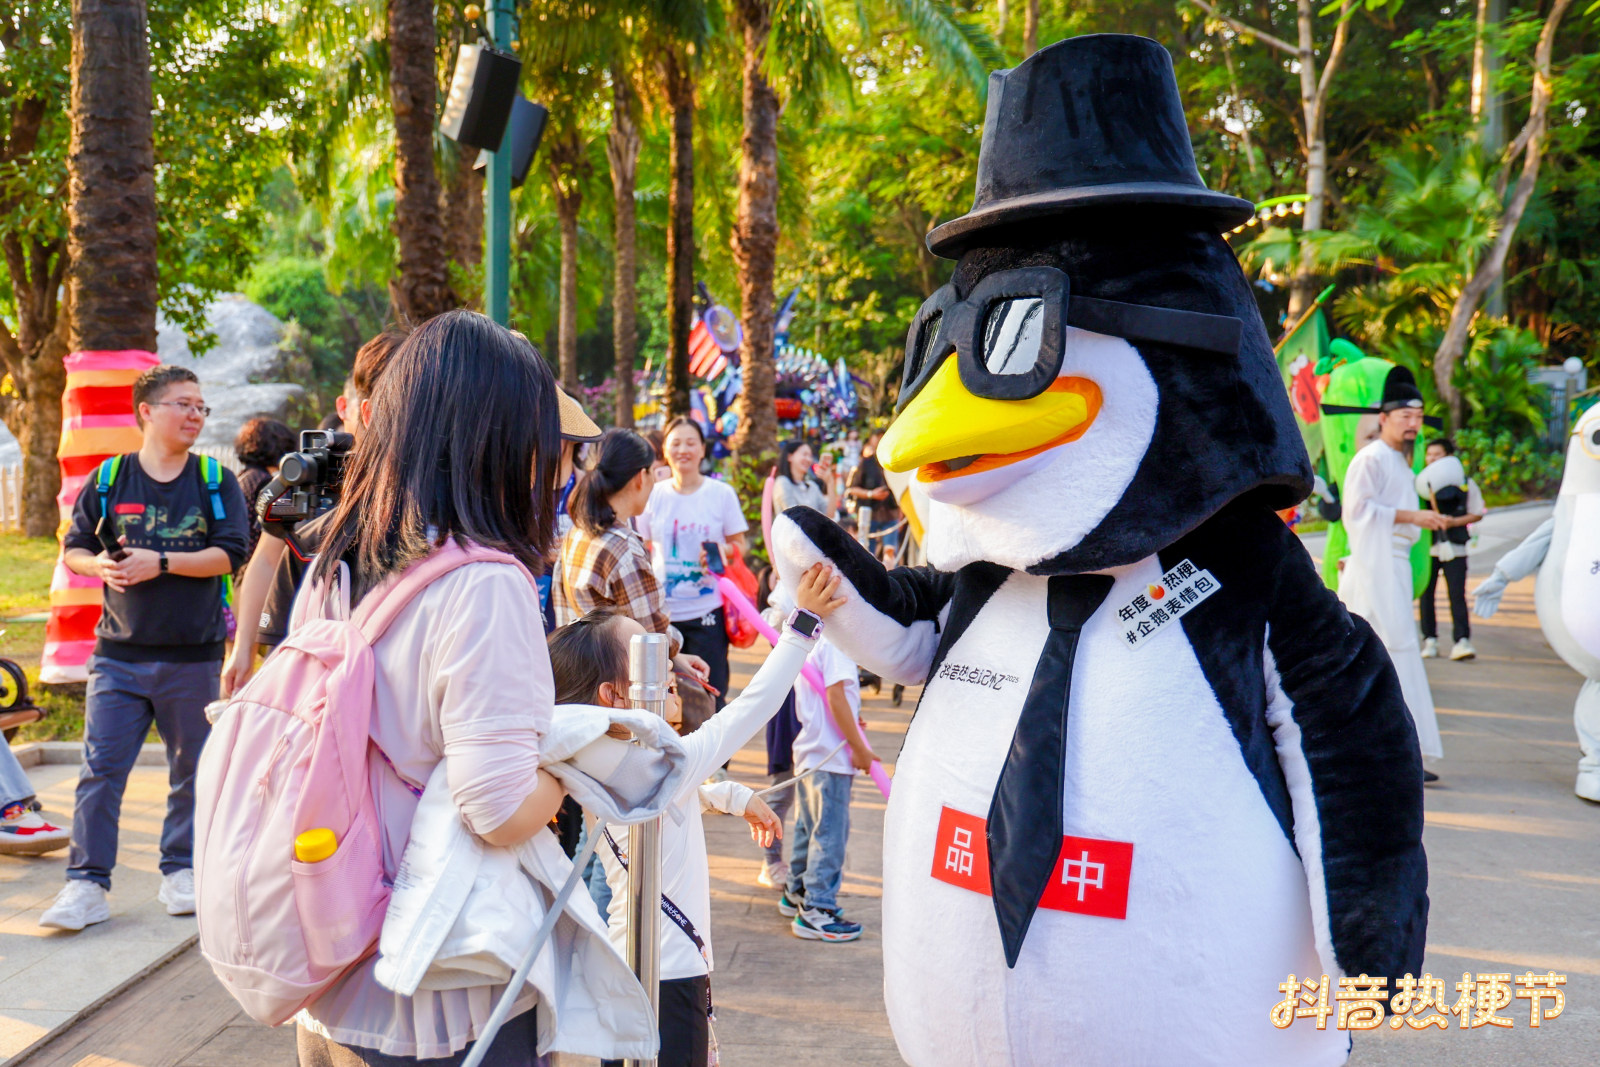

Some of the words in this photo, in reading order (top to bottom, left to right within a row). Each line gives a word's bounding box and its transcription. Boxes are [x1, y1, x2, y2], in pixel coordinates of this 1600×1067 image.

[114, 503, 207, 538] FILA
[1118, 594, 1152, 622] 年度
[1162, 561, 1197, 590] 热梗
[1126, 576, 1214, 644] #企鹅表情包
[945, 826, 974, 877] 品
[1061, 850, 1105, 902] 中
